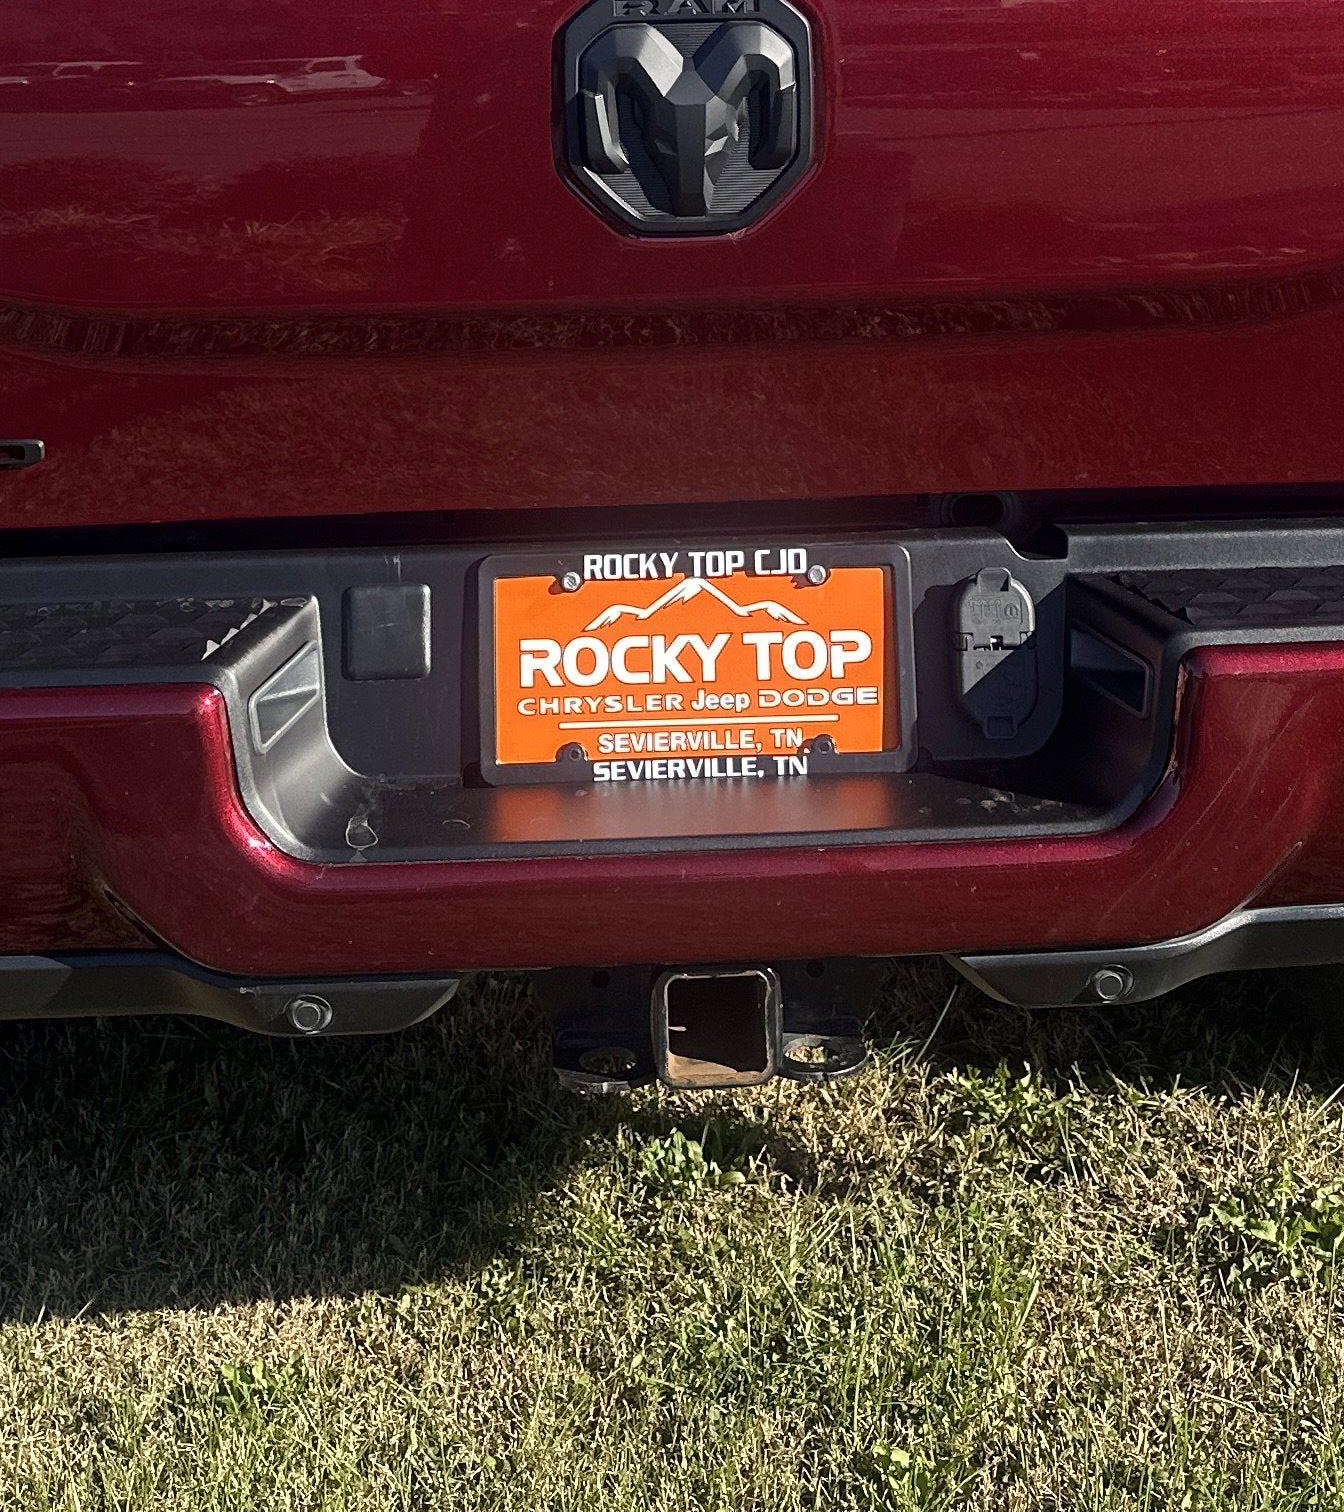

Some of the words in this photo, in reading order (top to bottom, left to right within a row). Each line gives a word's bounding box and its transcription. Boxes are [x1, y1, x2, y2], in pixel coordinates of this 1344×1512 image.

[583, 552, 679, 581] ROCKY
[688, 550, 745, 579] TOP
[755, 548, 807, 576] CJD
[518, 632, 732, 689] ROCKY
[742, 629, 873, 681] TOP
[517, 693, 684, 716] CHRYSLER
[691, 689, 750, 713] Jeep
[758, 686, 879, 708] DODGE
[597, 729, 763, 755] SEVIERVILLE,
[769, 727, 803, 749] TN
[593, 756, 765, 782] SEVIERVILLE,
[773, 755, 808, 777] TN
